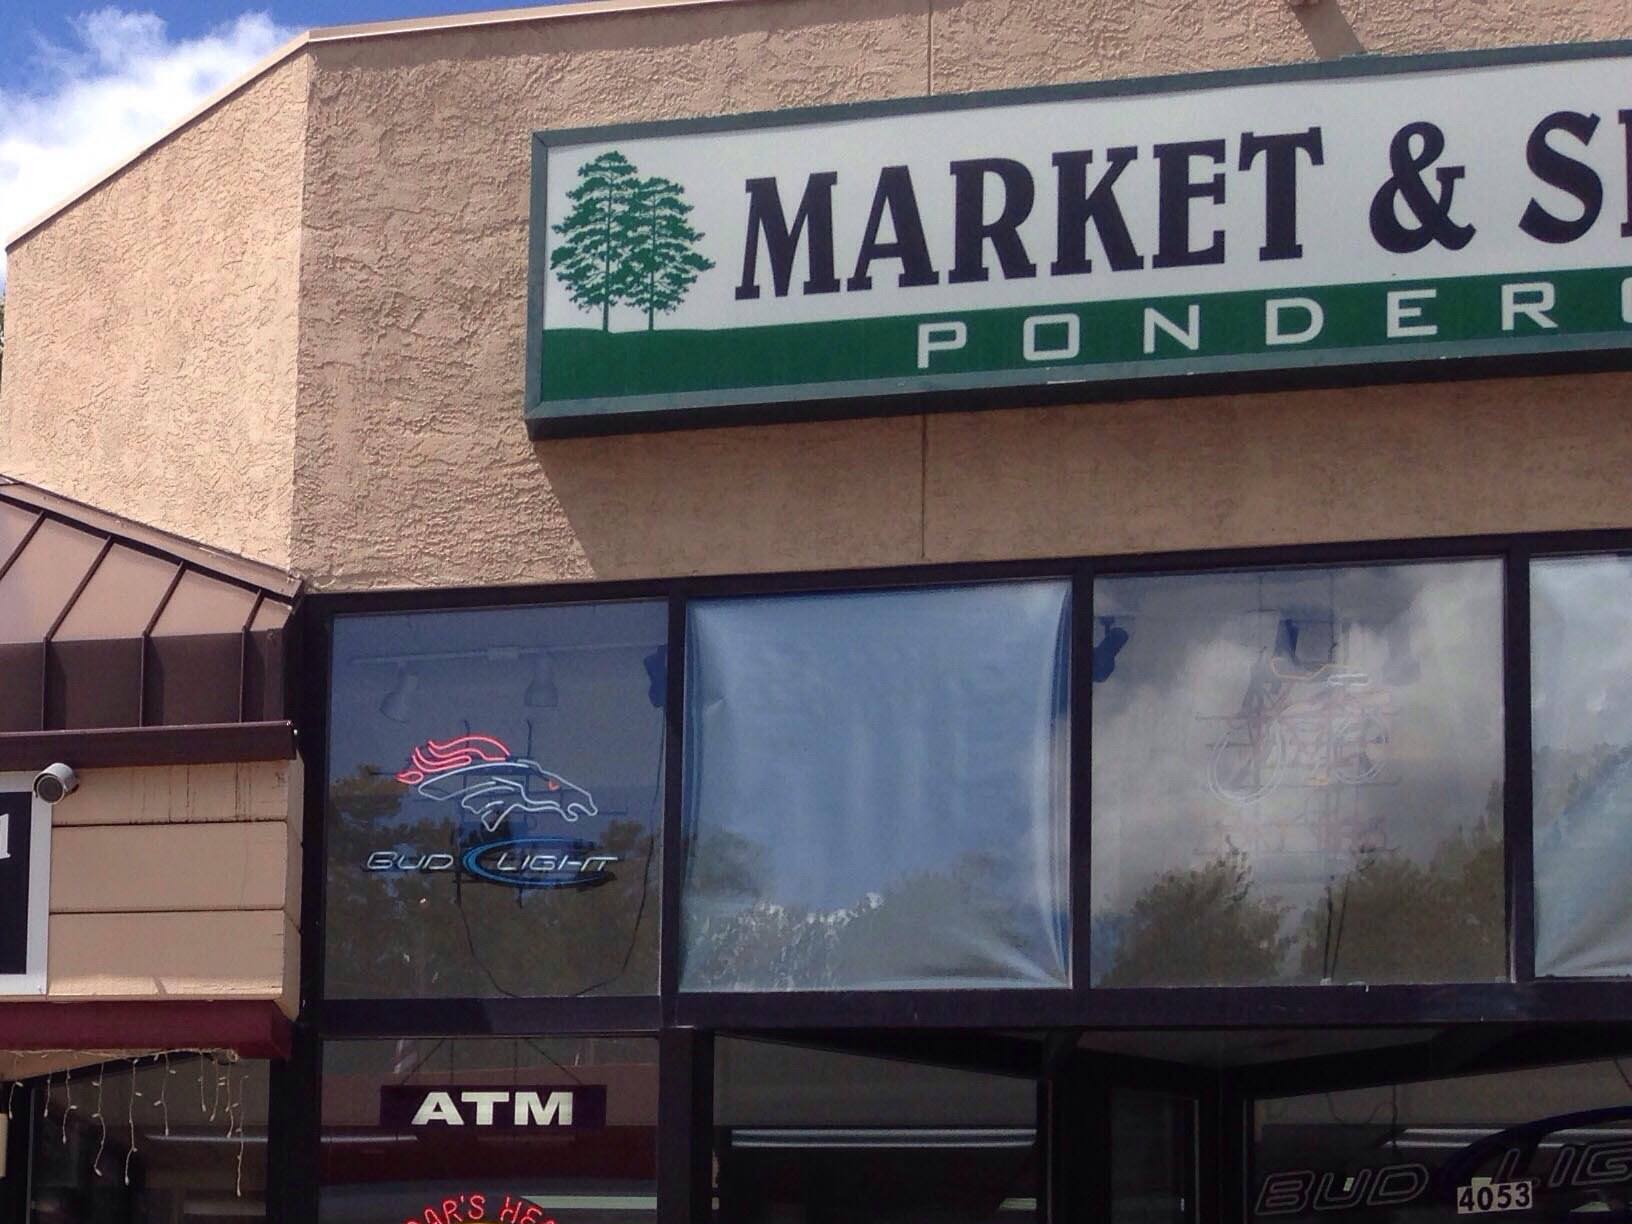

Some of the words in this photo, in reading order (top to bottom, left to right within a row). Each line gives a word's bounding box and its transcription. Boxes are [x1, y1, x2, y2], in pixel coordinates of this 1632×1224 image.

[734, 125, 1325, 301] MARKET
[1368, 120, 1476, 254] &
[1518, 110, 1632, 244] S
[917, 277, 1632, 369] PONDER
[366, 851, 454, 871] BUD
[496, 855, 619, 872] LIGHT
[411, 1091, 574, 1127] ATM
[1256, 1163, 1430, 1216] BUD
[1459, 1182, 1532, 1212] 4053
